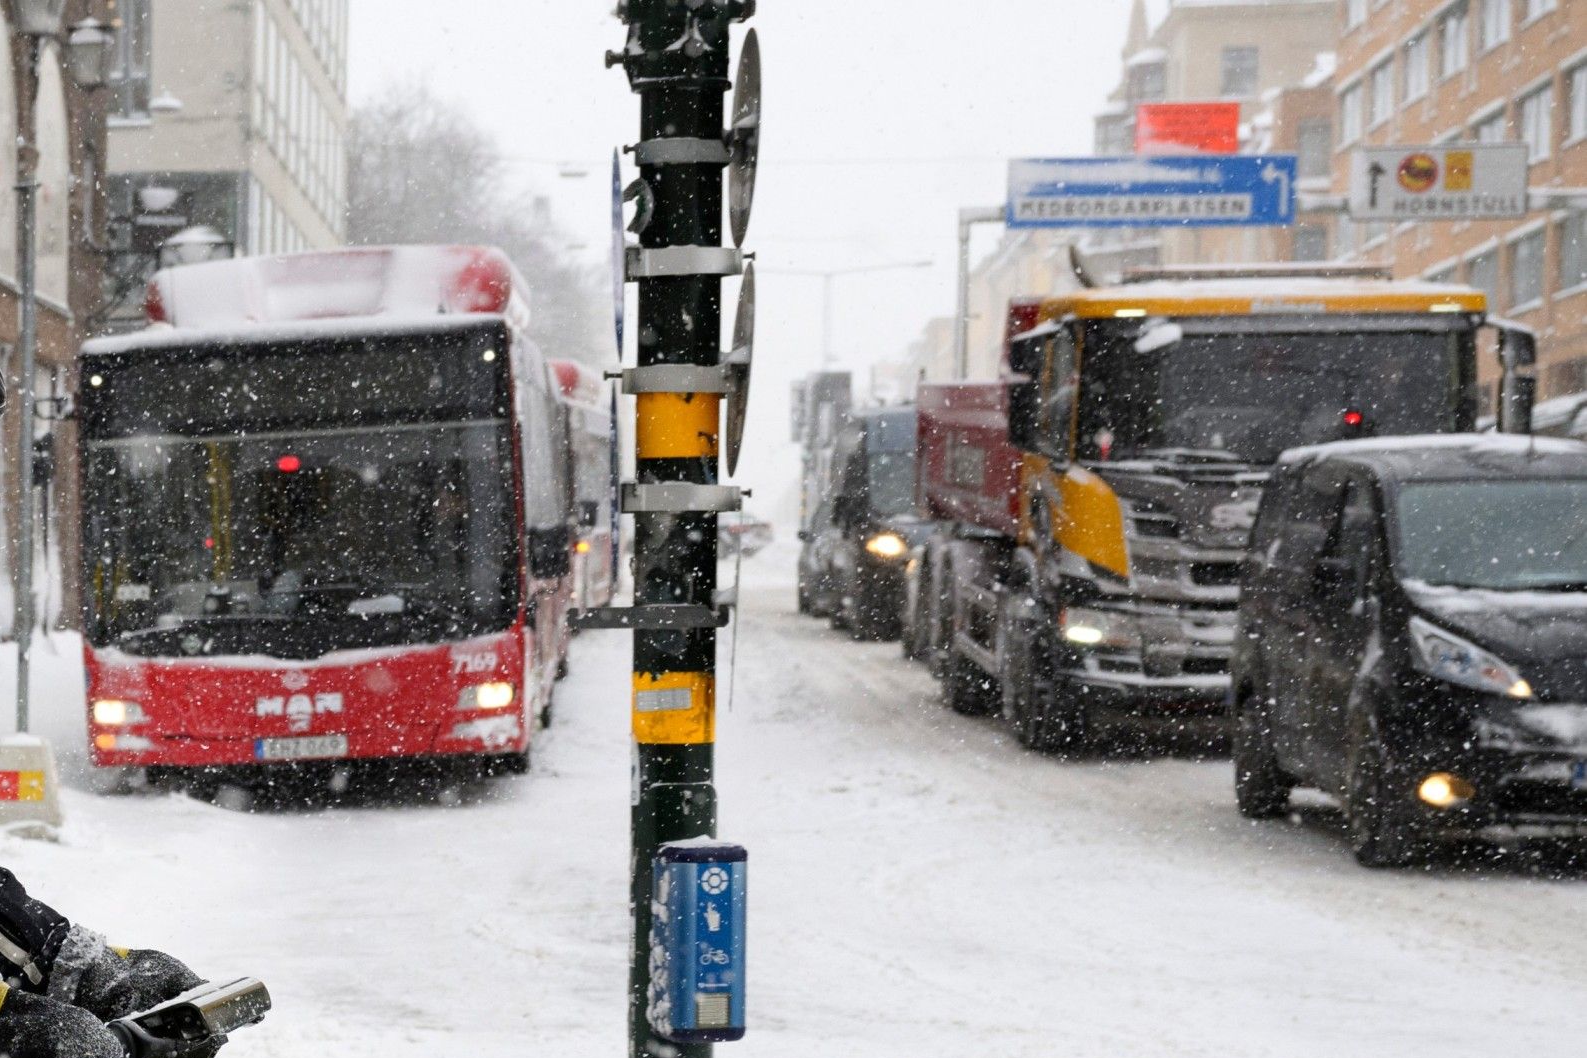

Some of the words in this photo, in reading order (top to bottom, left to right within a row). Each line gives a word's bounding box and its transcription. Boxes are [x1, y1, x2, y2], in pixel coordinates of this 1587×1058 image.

[1020, 198, 1245, 216] MEDBORGARPLATSEN
[1392, 195, 1519, 213] HORNSTULL
[256, 692, 344, 717] MAN
